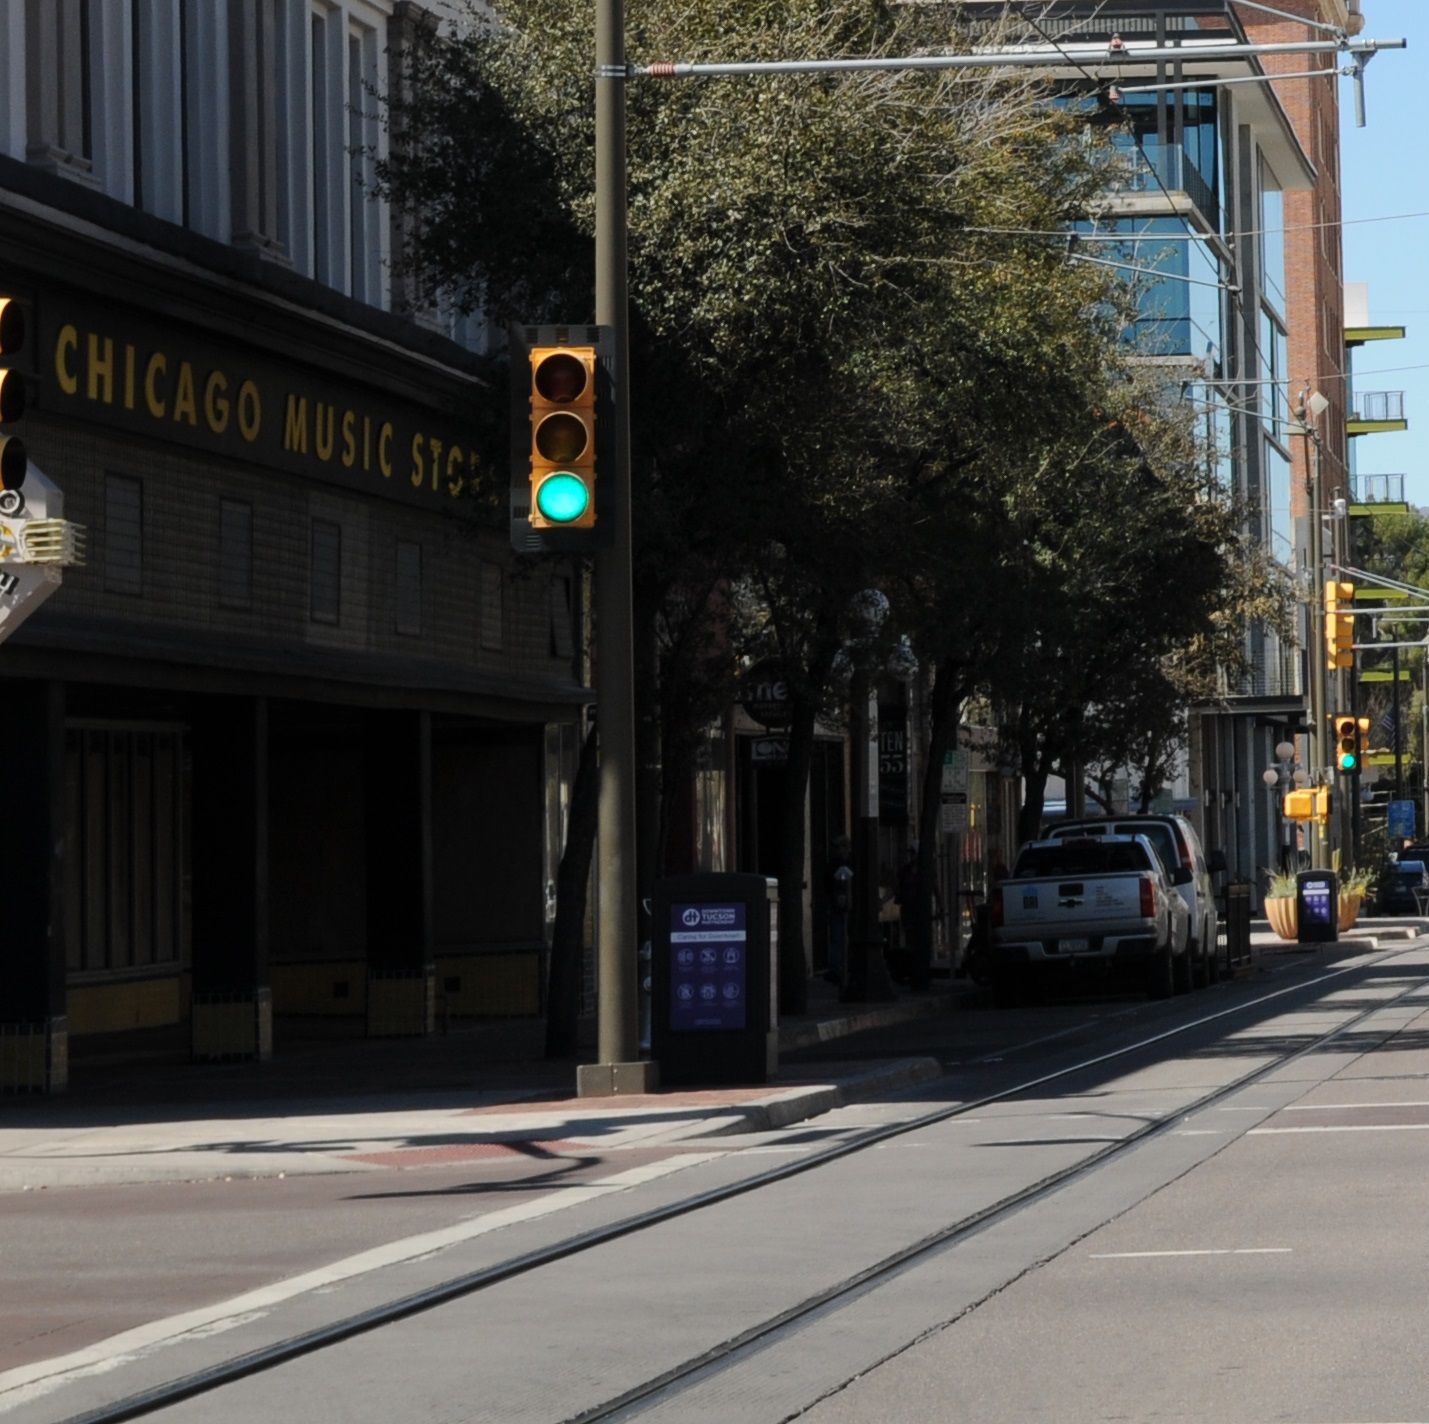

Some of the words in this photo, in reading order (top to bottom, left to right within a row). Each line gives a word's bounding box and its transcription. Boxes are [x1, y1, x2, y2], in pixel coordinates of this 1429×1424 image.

[56, 323, 262, 442] CHICAGO
[284, 393, 394, 479] MUSIC
[880, 730, 904, 752] TEN
[880, 754, 904, 774] 55
